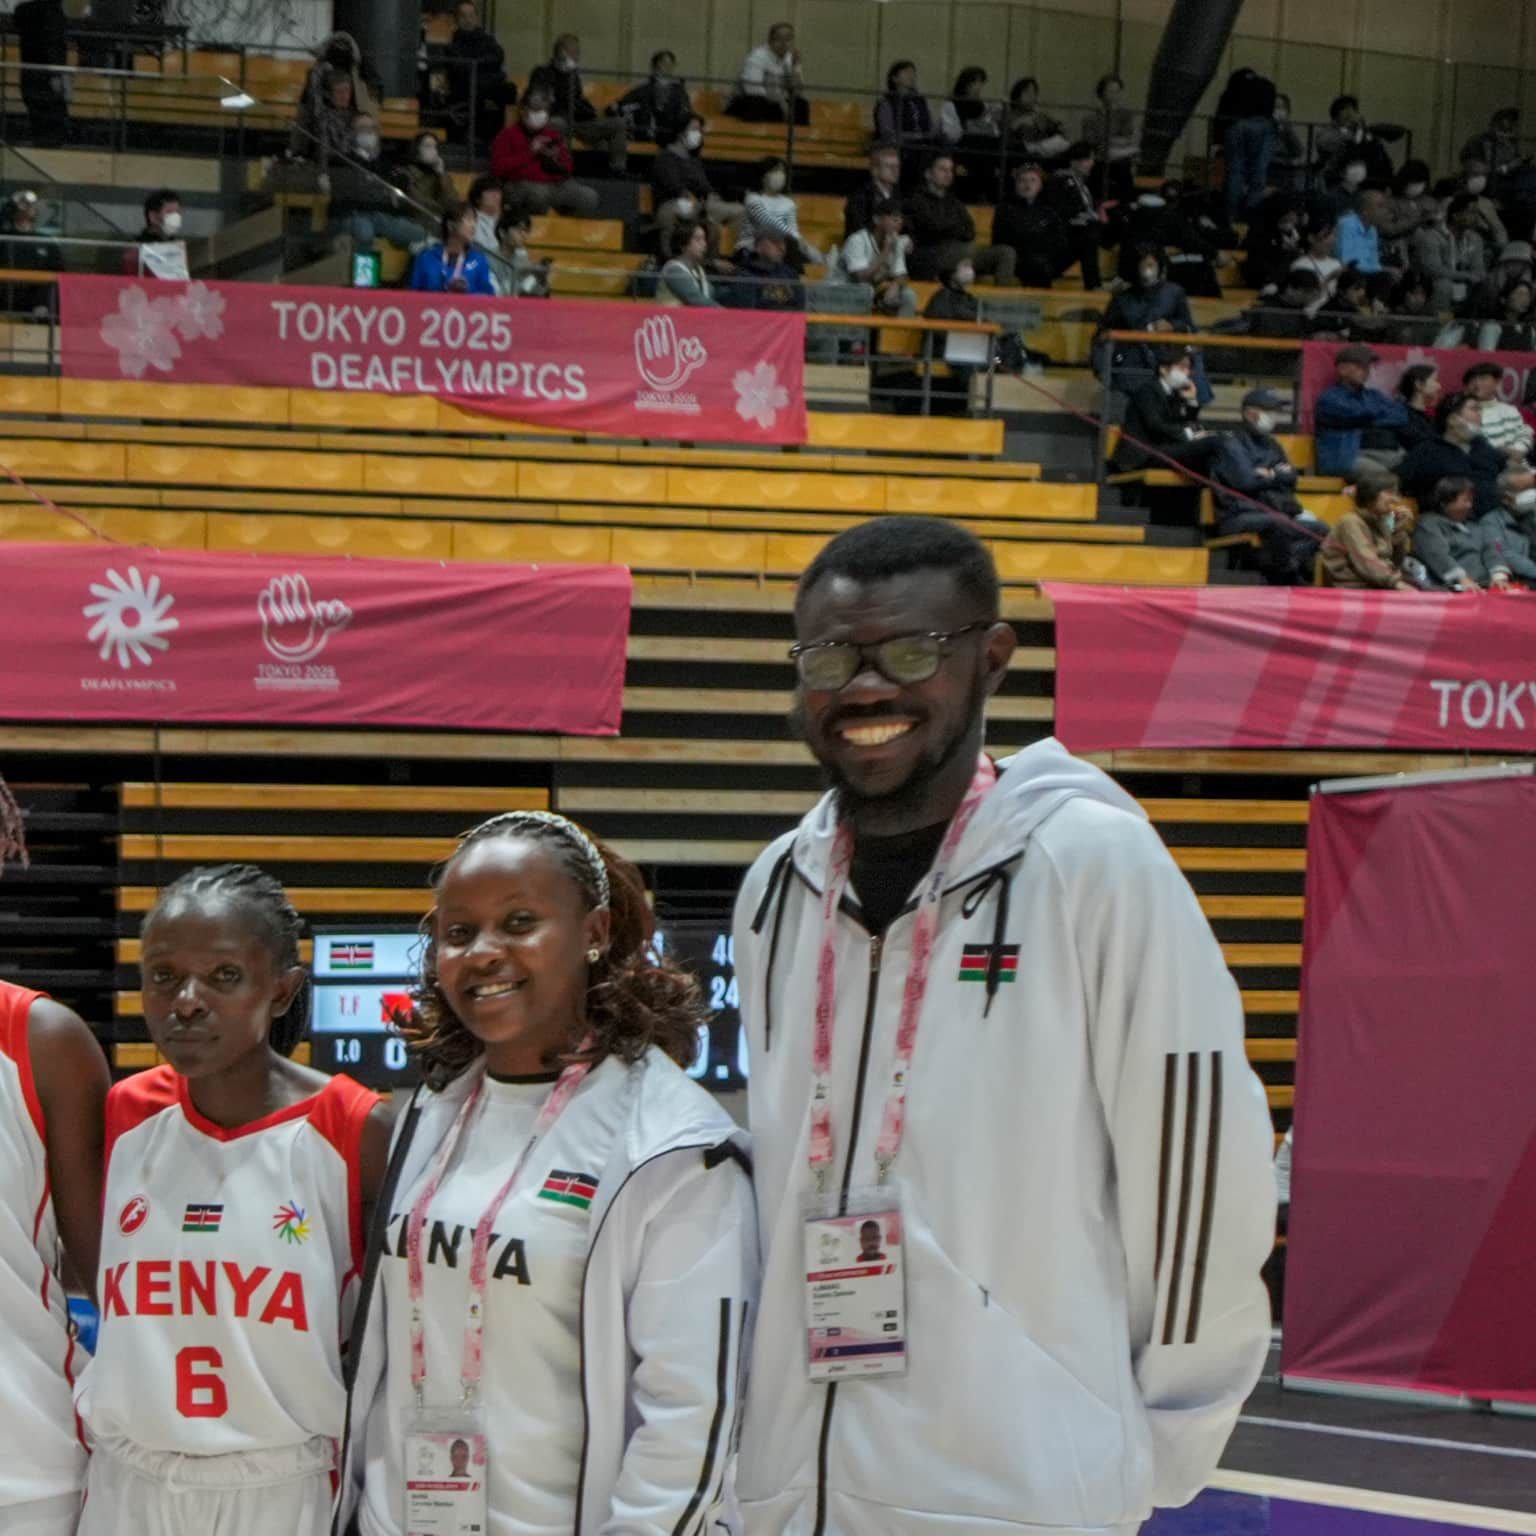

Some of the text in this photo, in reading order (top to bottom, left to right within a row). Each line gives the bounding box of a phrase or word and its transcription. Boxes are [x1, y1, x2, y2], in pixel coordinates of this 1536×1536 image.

[271, 301, 513, 353] TOKYO 2025
[310, 351, 588, 401] DEAFLYMPICS
[1430, 679, 1536, 730] TOK
[103, 1259, 310, 1332] KENYA
[175, 1345, 230, 1419] 6
